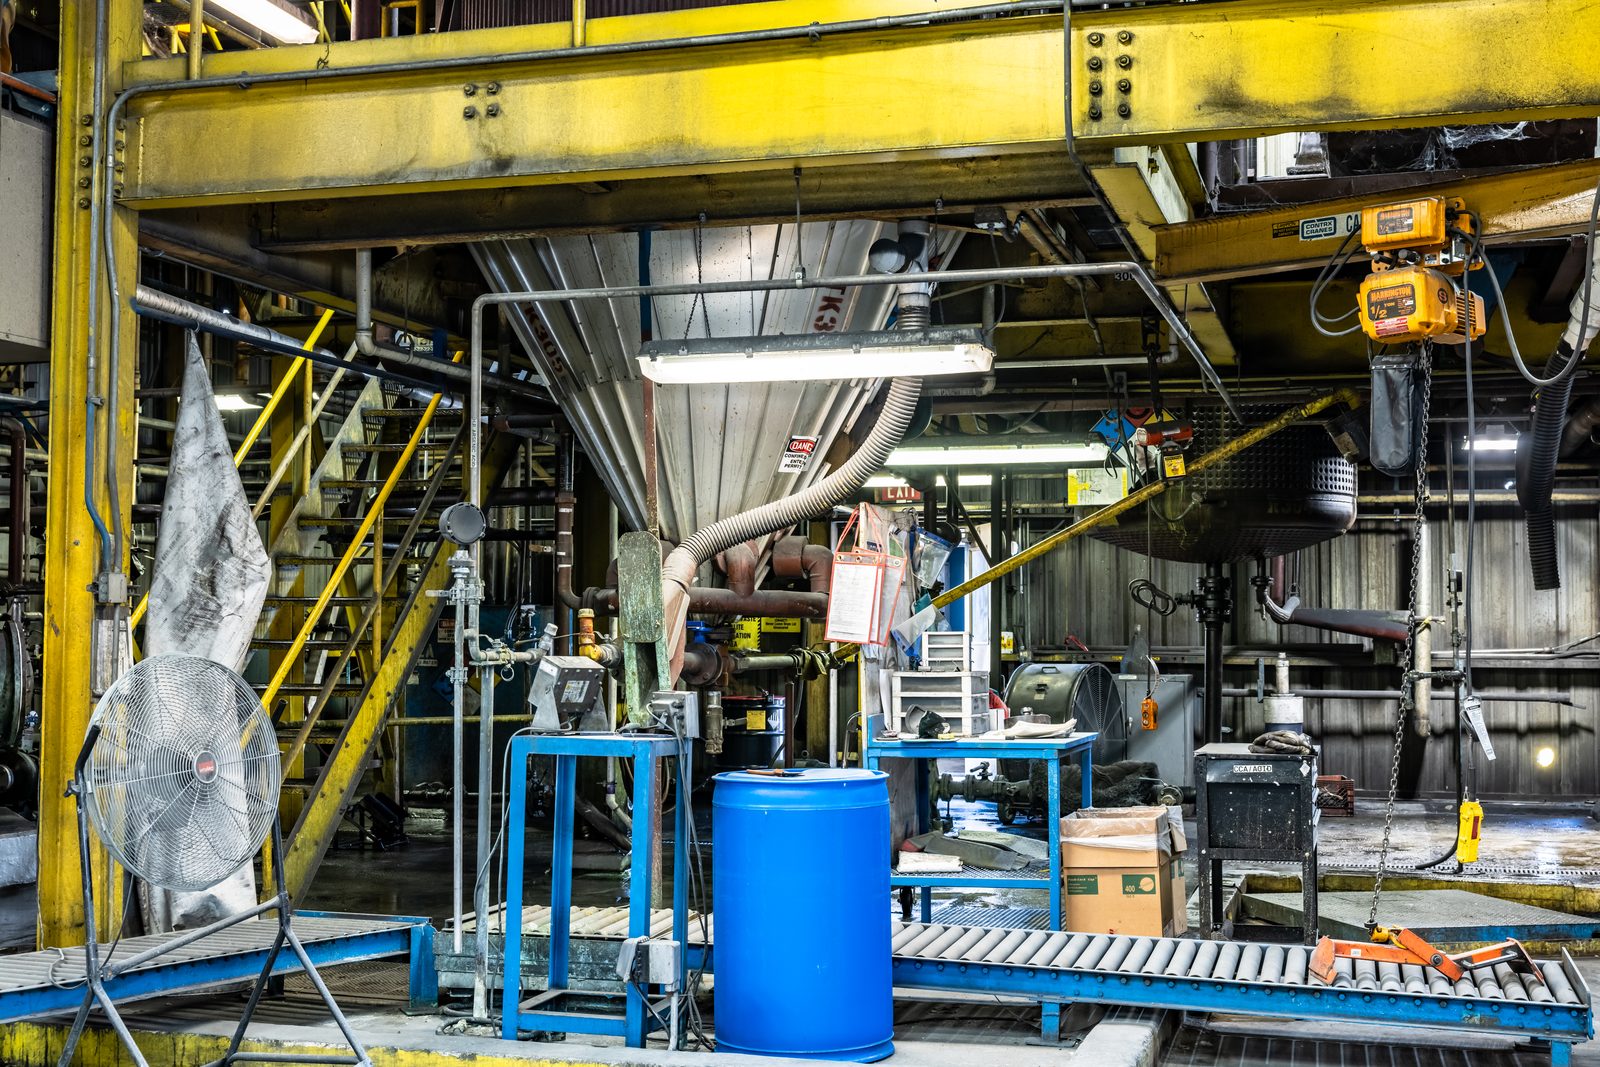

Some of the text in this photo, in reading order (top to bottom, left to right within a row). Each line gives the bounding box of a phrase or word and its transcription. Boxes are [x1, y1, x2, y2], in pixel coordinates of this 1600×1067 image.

[1305, 220, 1333, 230] CONTRX
[1305, 226, 1333, 235] CRANES
[1370, 286, 1412, 303] HARRINGTON
[1370, 305, 1388, 319] 1/2
[887, 486, 915, 499] EXIT
